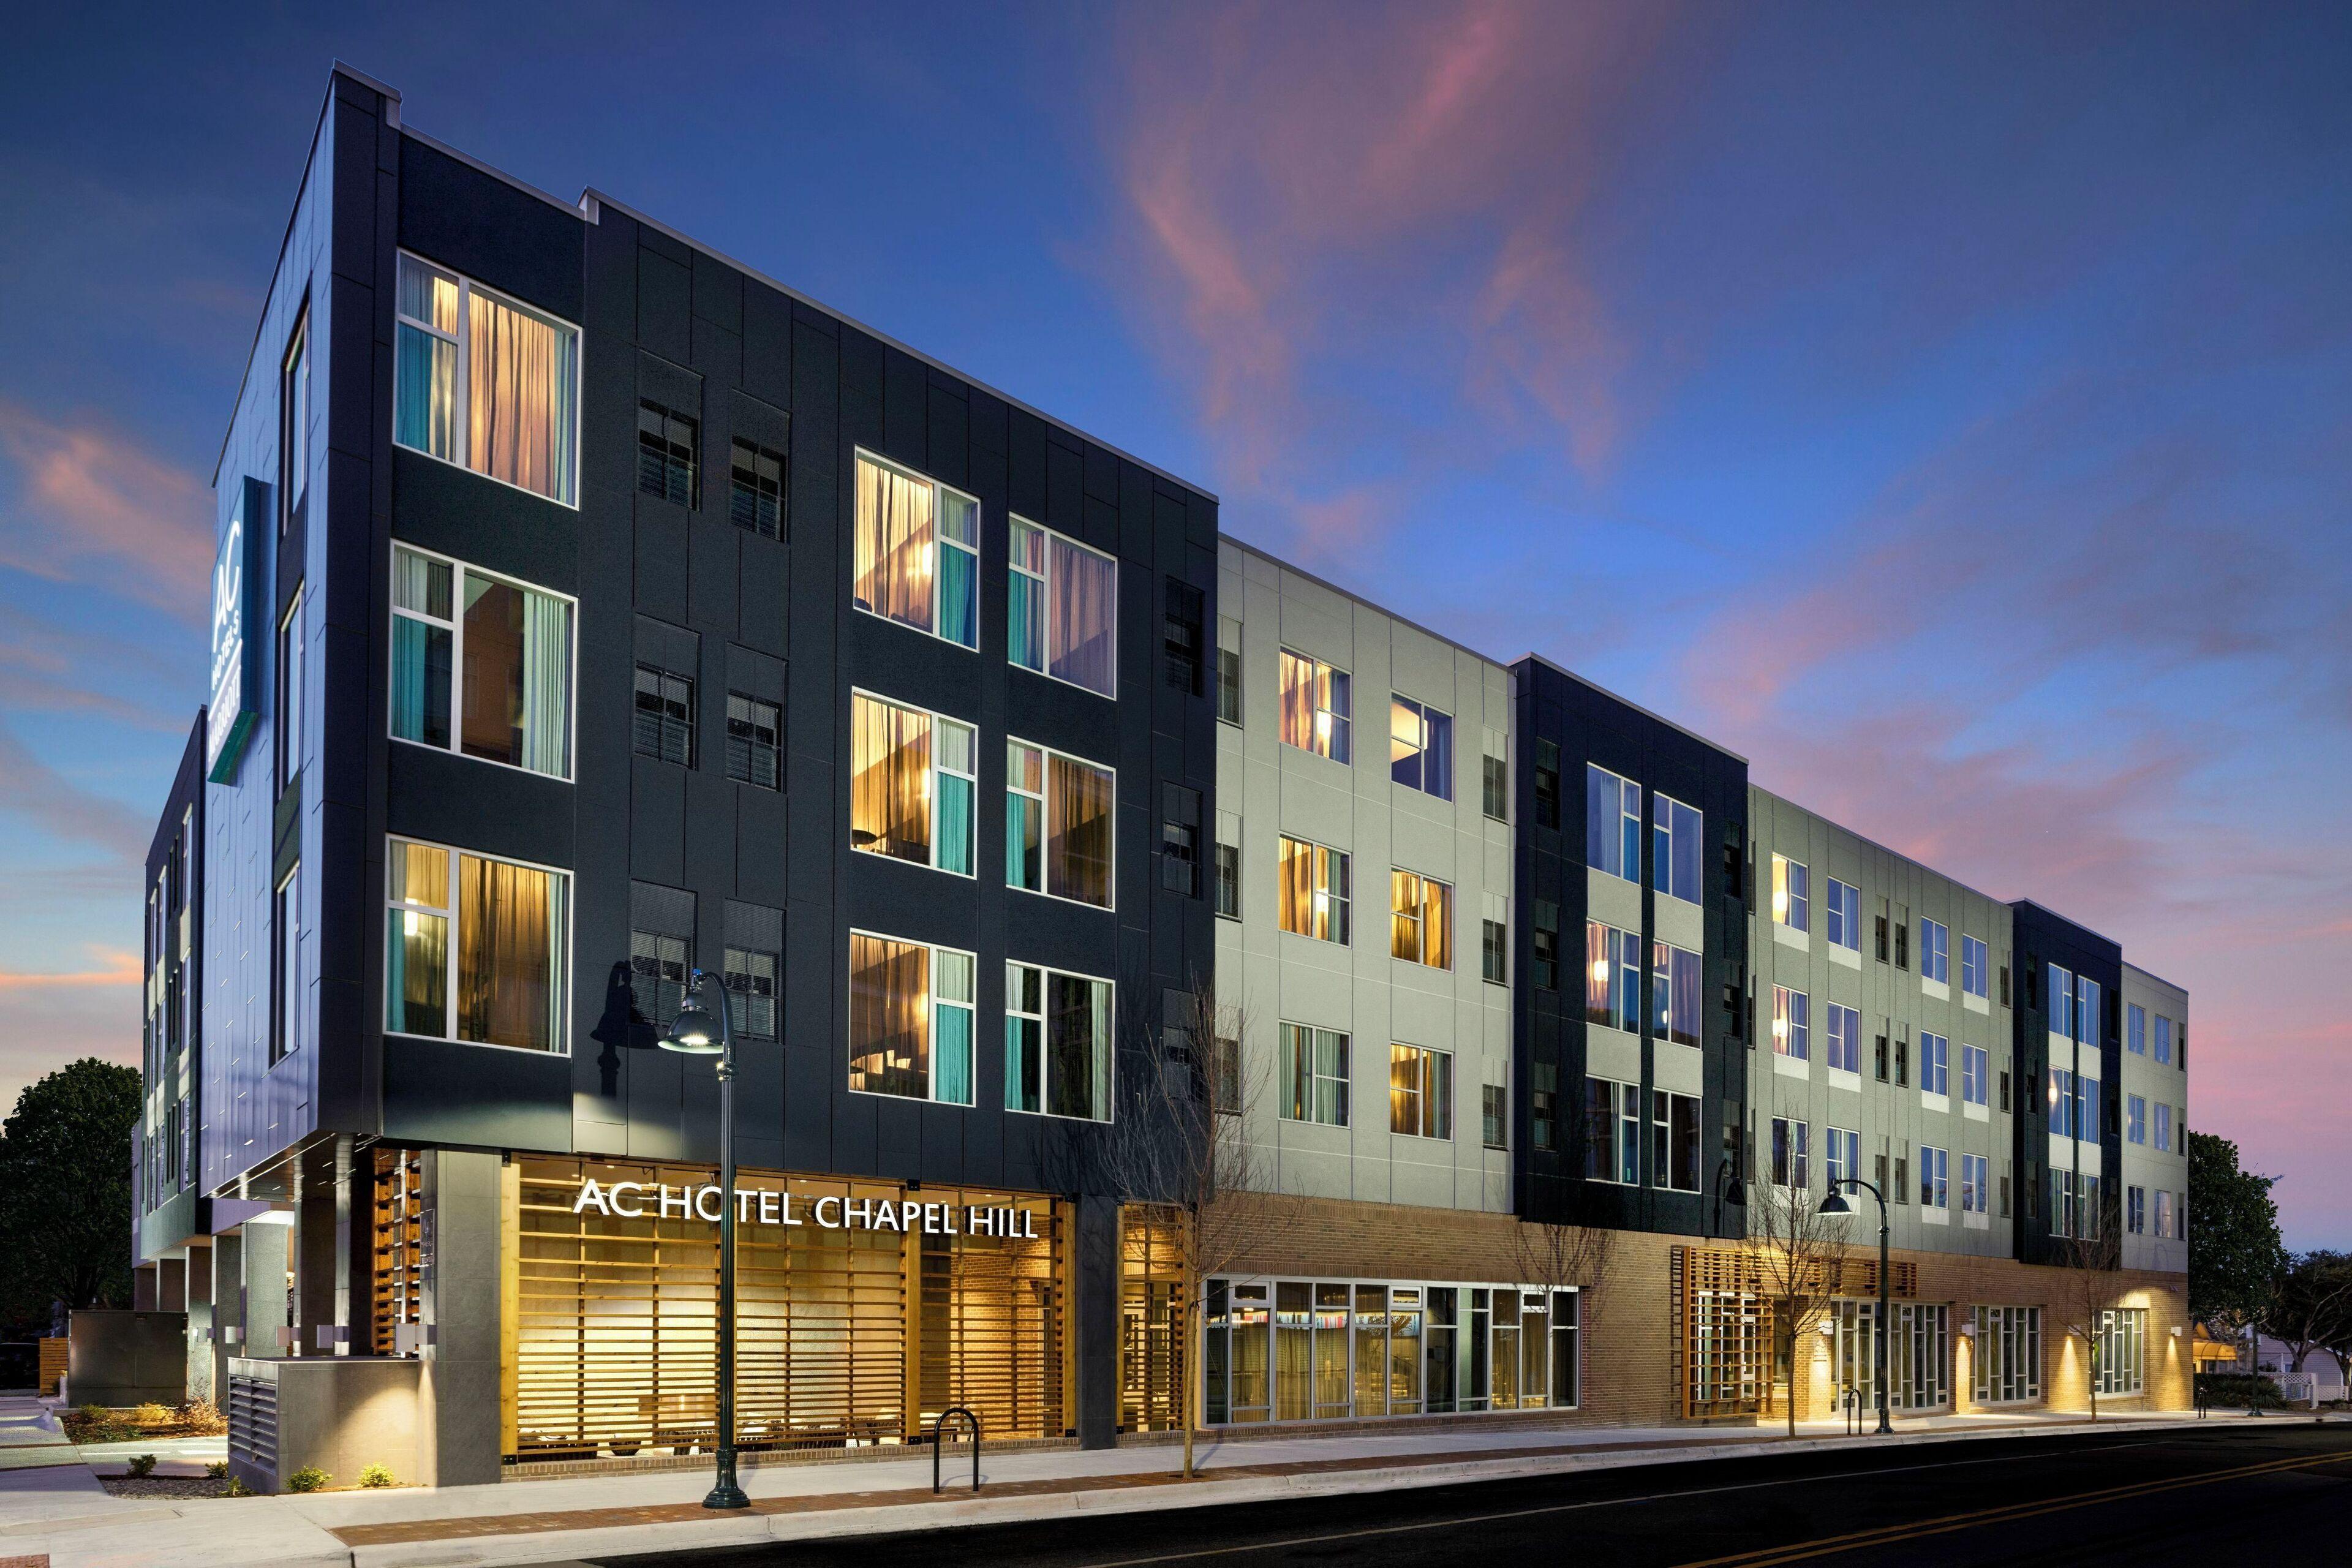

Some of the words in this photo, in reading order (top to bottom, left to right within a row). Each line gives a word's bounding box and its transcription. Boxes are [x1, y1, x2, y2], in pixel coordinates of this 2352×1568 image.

[213, 521, 240, 653] AC
[208, 665, 241, 762] MARRIOTT
[572, 1178, 643, 1217] AC
[660, 1184, 803, 1225] HOTEL
[815, 1196, 957, 1234] CHAPEL
[970, 1205, 1038, 1238] HILL
